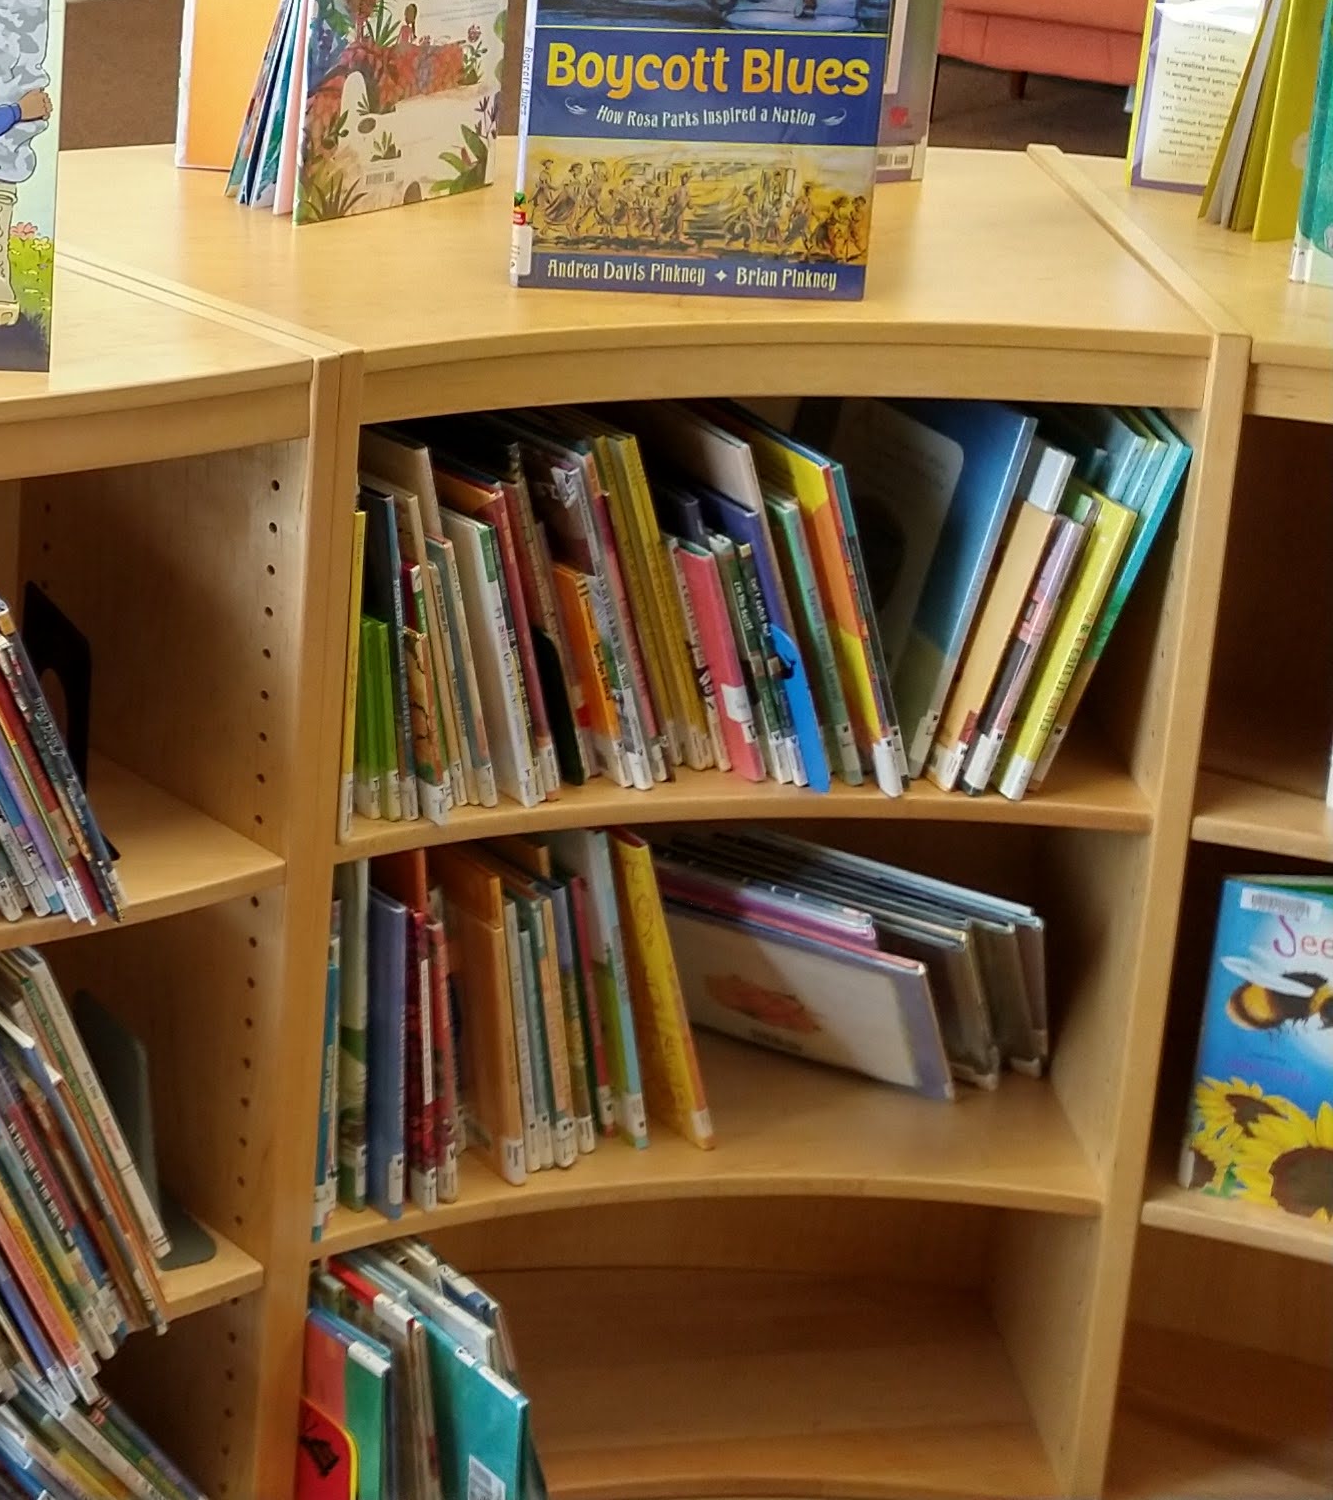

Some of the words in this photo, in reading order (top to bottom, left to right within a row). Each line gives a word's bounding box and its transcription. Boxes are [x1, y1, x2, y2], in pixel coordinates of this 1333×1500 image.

[523, 46, 533, 86] Boycott
[547, 42, 728, 99] Boycott
[742, 49, 870, 96] Blues
[596, 104, 624, 125] How
[627, 106, 659, 127] Rosa
[662, 107, 700, 129] Parks
[703, 105, 757, 129] Inspired
[760, 108, 768, 123] a
[772, 105, 816, 127] Nation
[547, 259, 599, 280] Andrea
[603, 260, 646, 282] Davis
[650, 263, 706, 287] Pinkney
[736, 265, 778, 288] Brian
[781, 269, 837, 292] Pinkney
